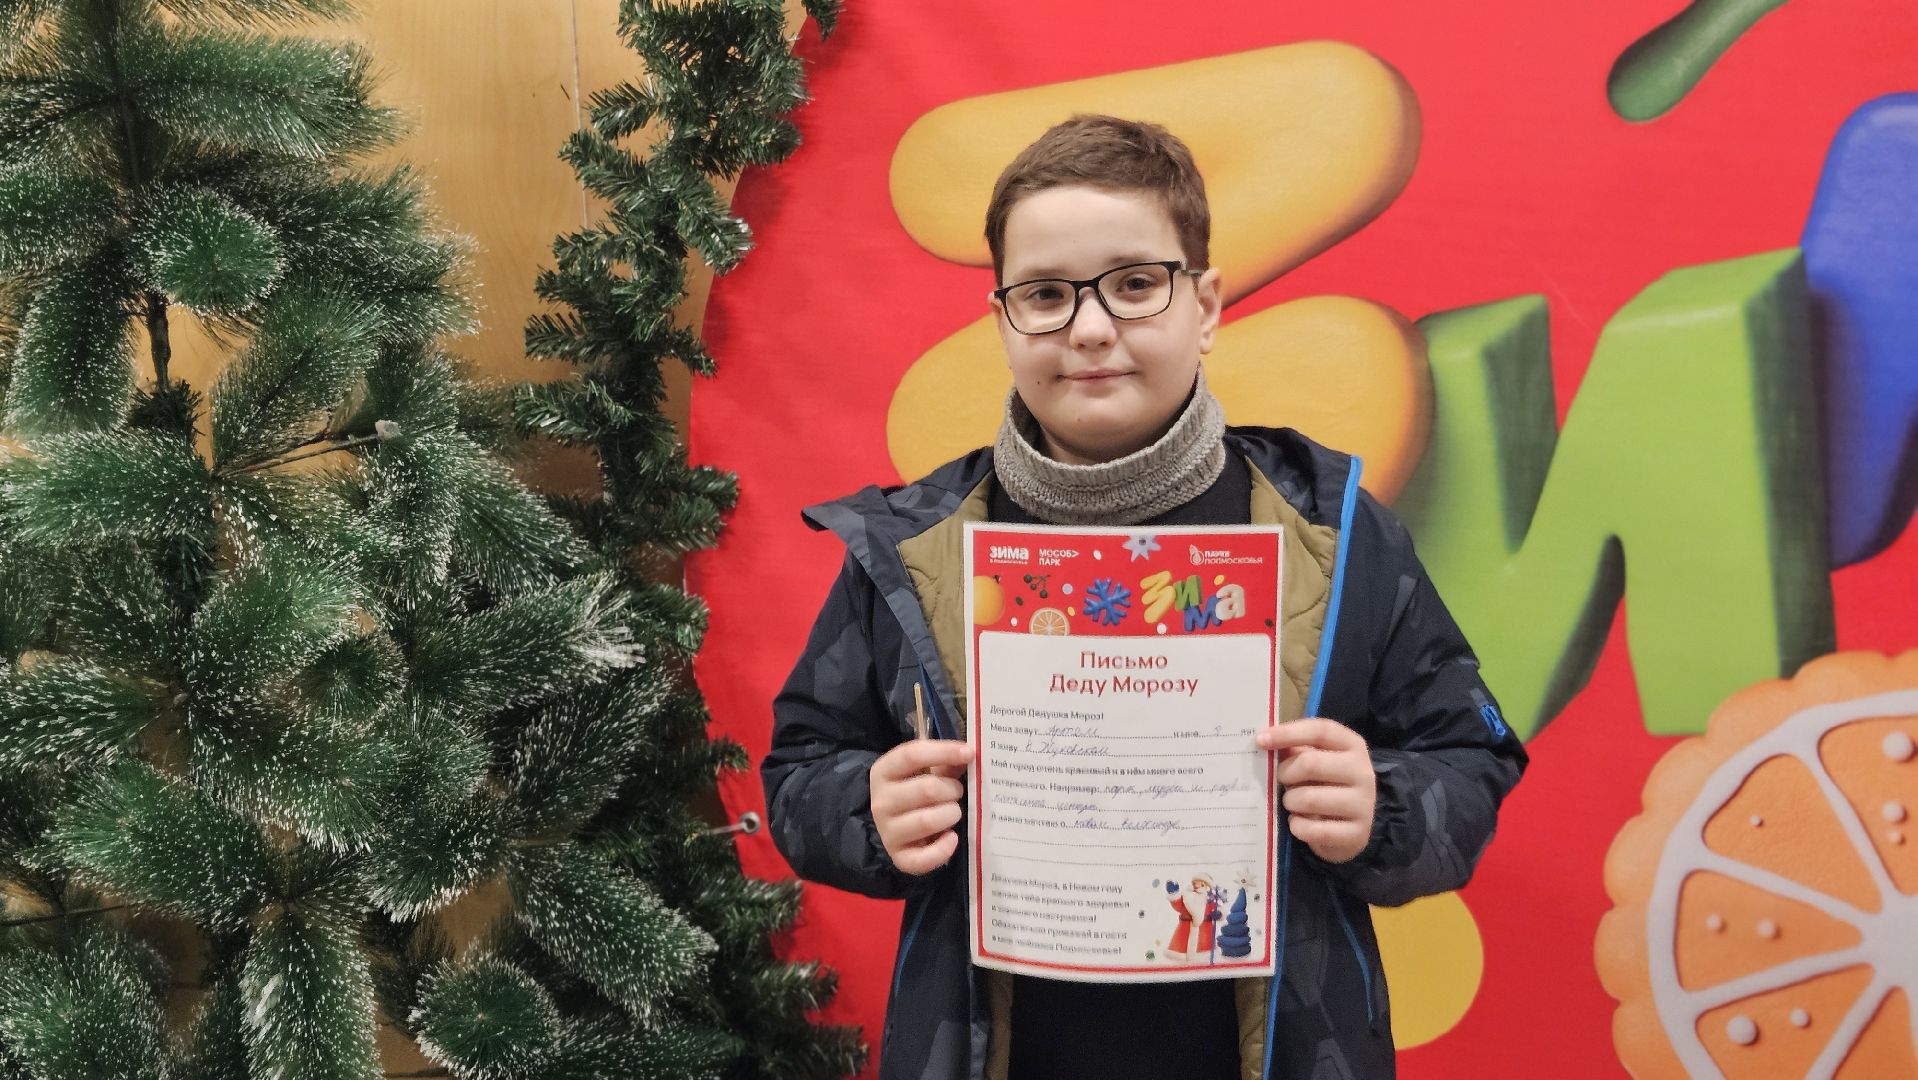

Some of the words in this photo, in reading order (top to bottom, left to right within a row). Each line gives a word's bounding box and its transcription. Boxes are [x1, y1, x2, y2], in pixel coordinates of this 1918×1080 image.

[1039, 558, 1061, 567] ПАРК
[1079, 650, 1169, 670] Письмо
[1049, 673, 1108, 698] Деду
[1112, 675, 1200, 699] Морозу
[989, 704, 1027, 717] Дорогой
[1028, 708, 1069, 720] Дедушка
[1070, 711, 1104, 722] Мороз!
[990, 722, 1013, 732] Меня
[1014, 727, 1038, 737] зовут
[990, 740, 996, 750] Я
[997, 744, 1018, 754] живу
[990, 760, 1008, 769] Мой
[1009, 763, 1035, 773] город
[1036, 766, 1064, 775] очень
[1065, 767, 1111, 776] красивый
[1146, 768, 1176, 776] много
[1177, 767, 1204, 776] всего
[1049, 782, 1100, 796] Например:
